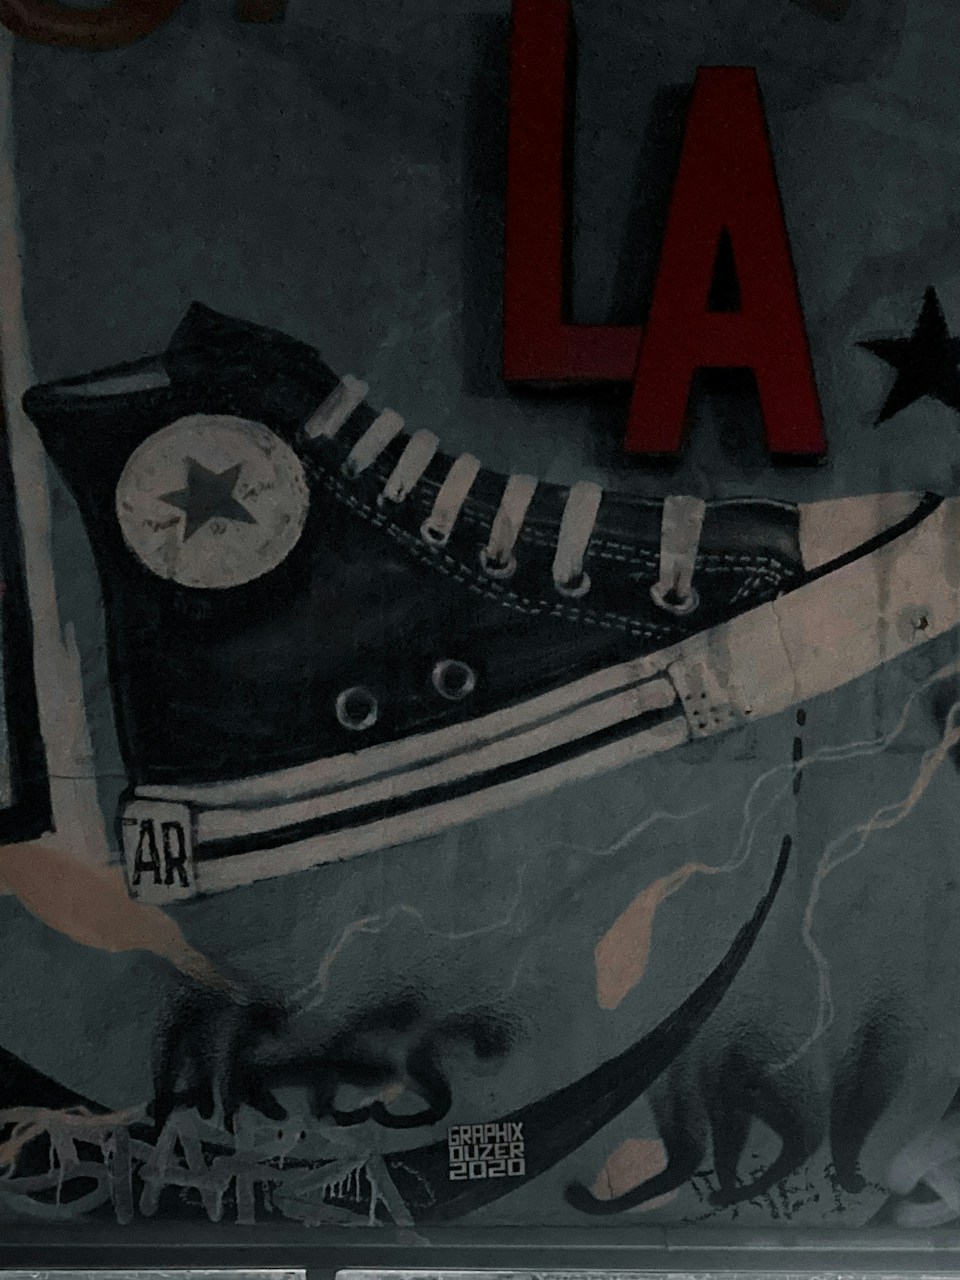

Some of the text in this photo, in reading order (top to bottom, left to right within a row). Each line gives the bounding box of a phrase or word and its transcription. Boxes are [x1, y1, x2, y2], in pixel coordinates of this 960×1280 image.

[132, 818, 189, 888] AR
[448, 1122, 524, 1146] GRAPHIX
[449, 1158, 526, 1181] 2020
